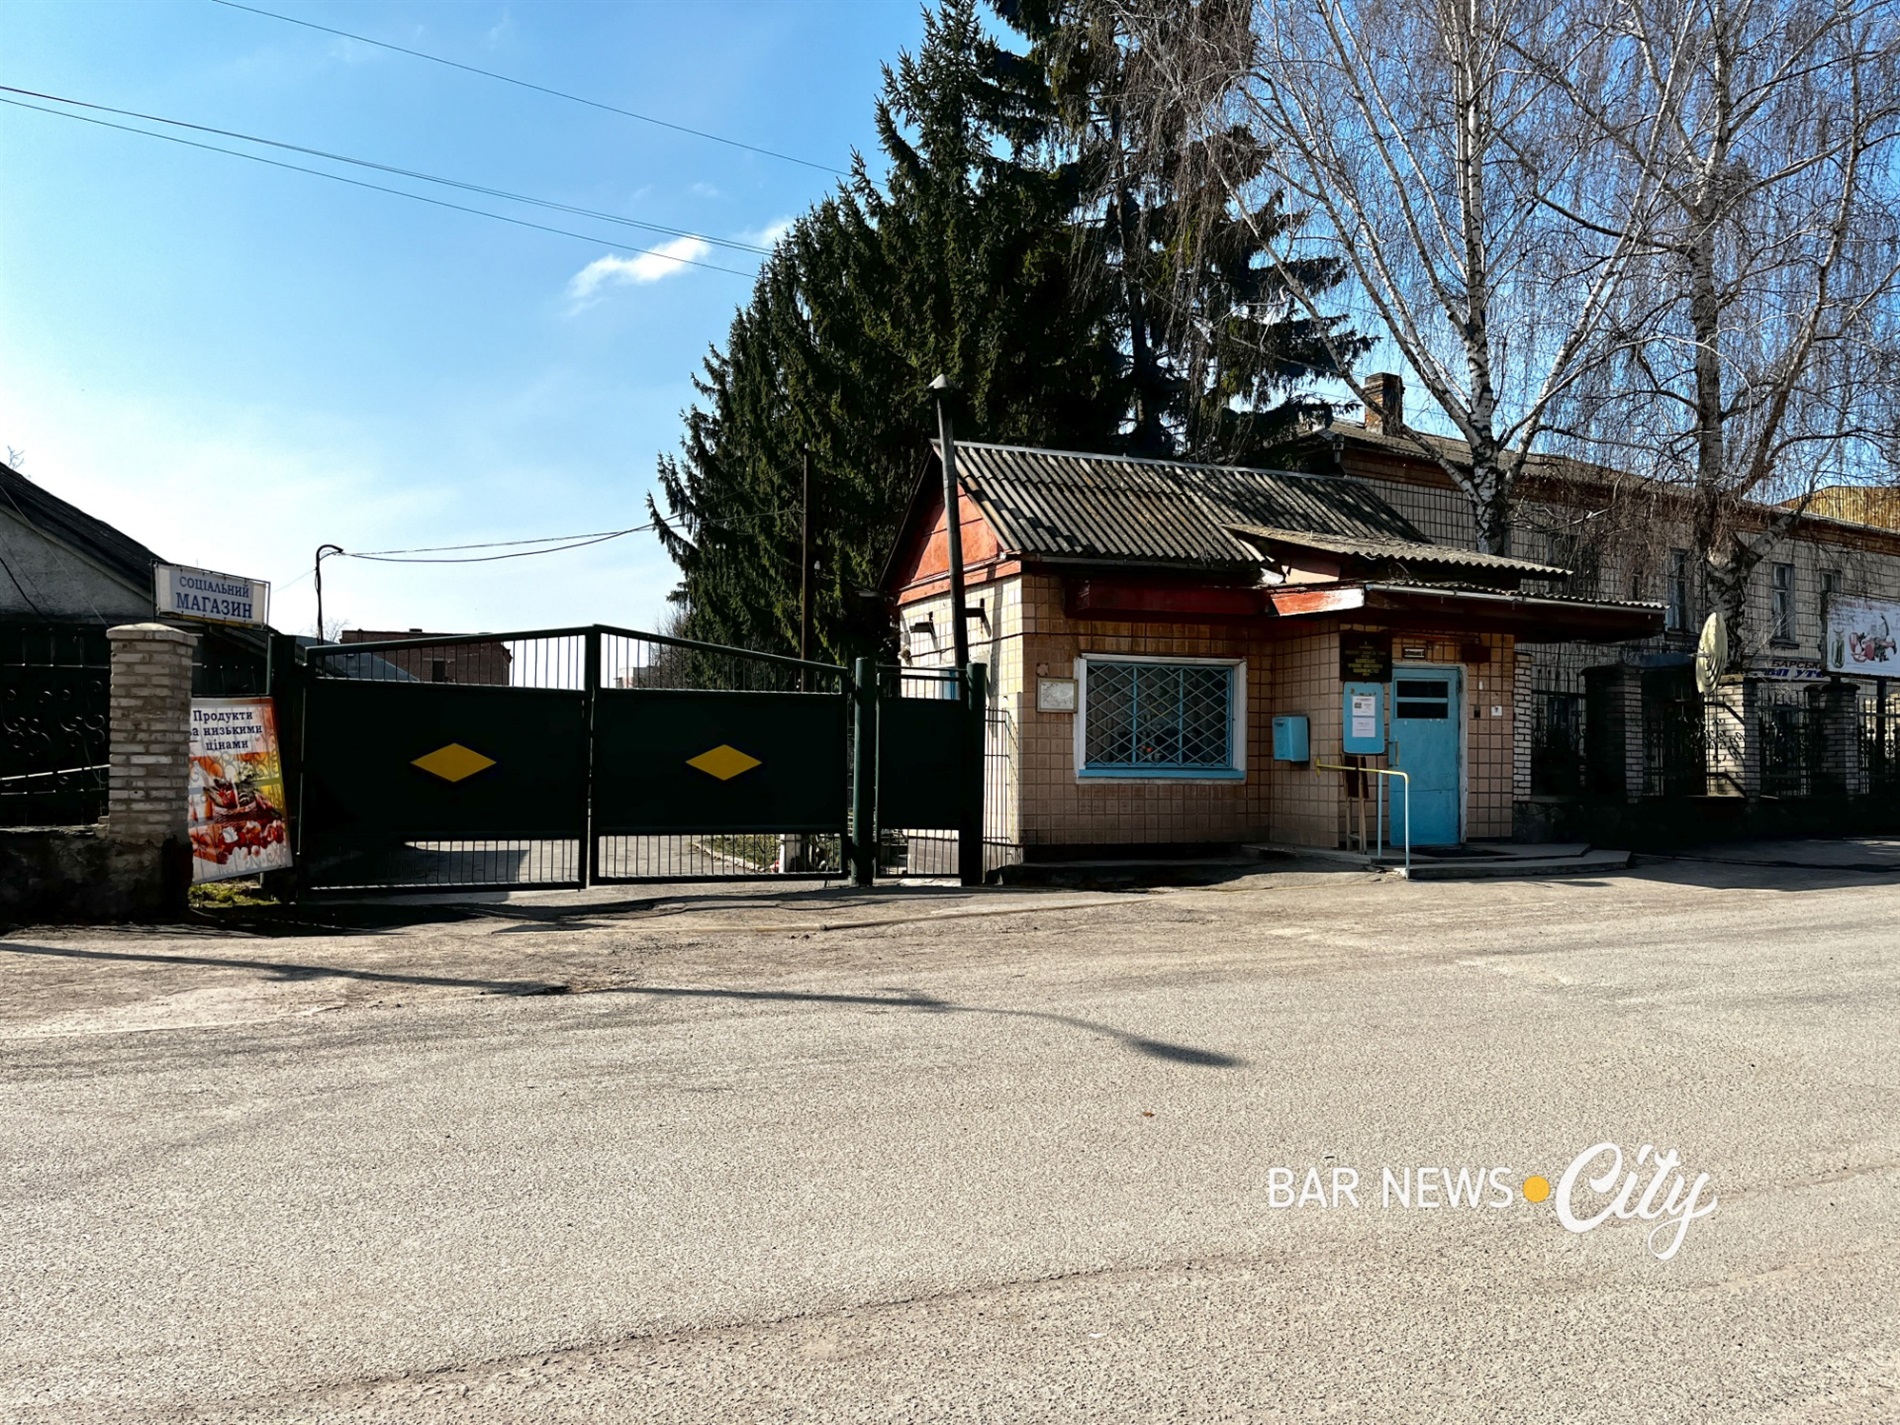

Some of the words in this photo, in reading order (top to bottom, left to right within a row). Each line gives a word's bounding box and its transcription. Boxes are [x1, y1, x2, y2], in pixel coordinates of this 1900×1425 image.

[179, 576, 250, 598] СОЦІАЛЬНИЙ
[175, 592, 253, 619] МАГАЗИН
[1771, 660, 1822, 670] БАРСЬК
[193, 709, 253, 724] Продукти
[189, 727, 200, 737] а
[203, 725, 263, 737] низькими
[206, 739, 249, 752] цінами
